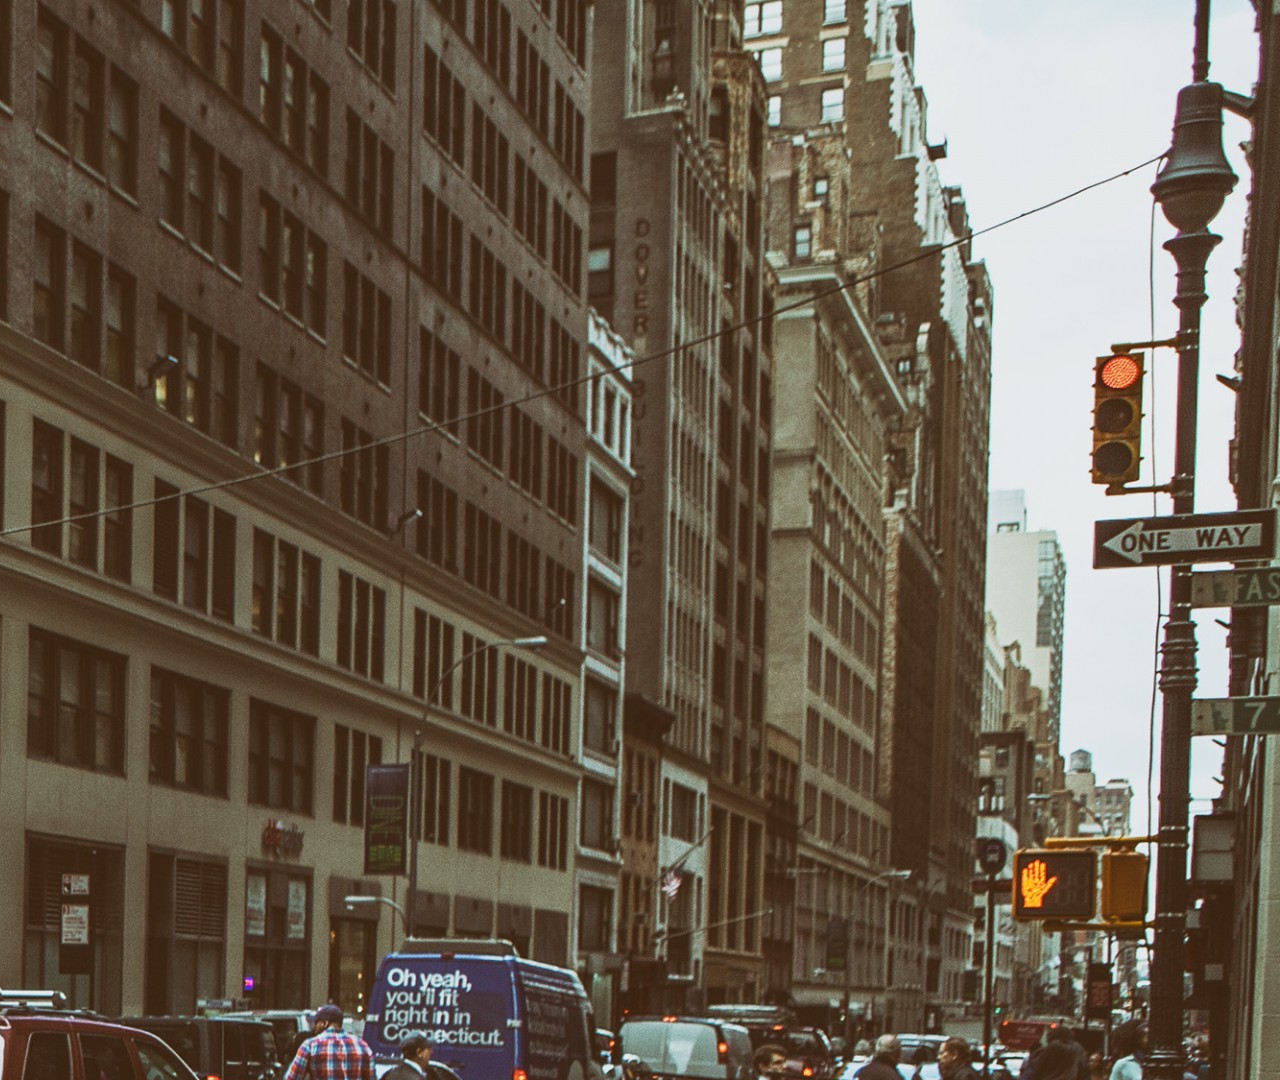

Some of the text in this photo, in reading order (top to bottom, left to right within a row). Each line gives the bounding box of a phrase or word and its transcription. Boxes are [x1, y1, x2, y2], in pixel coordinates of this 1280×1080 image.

[634, 219, 651, 333] DOVER
[1121, 526, 1251, 552] ONE WAY
[1244, 702, 1267, 729] 7
[387, 968, 472, 992] Oh yeah,
[385, 989, 460, 1008] you'll fit
[384, 1007, 471, 1027] right in in
